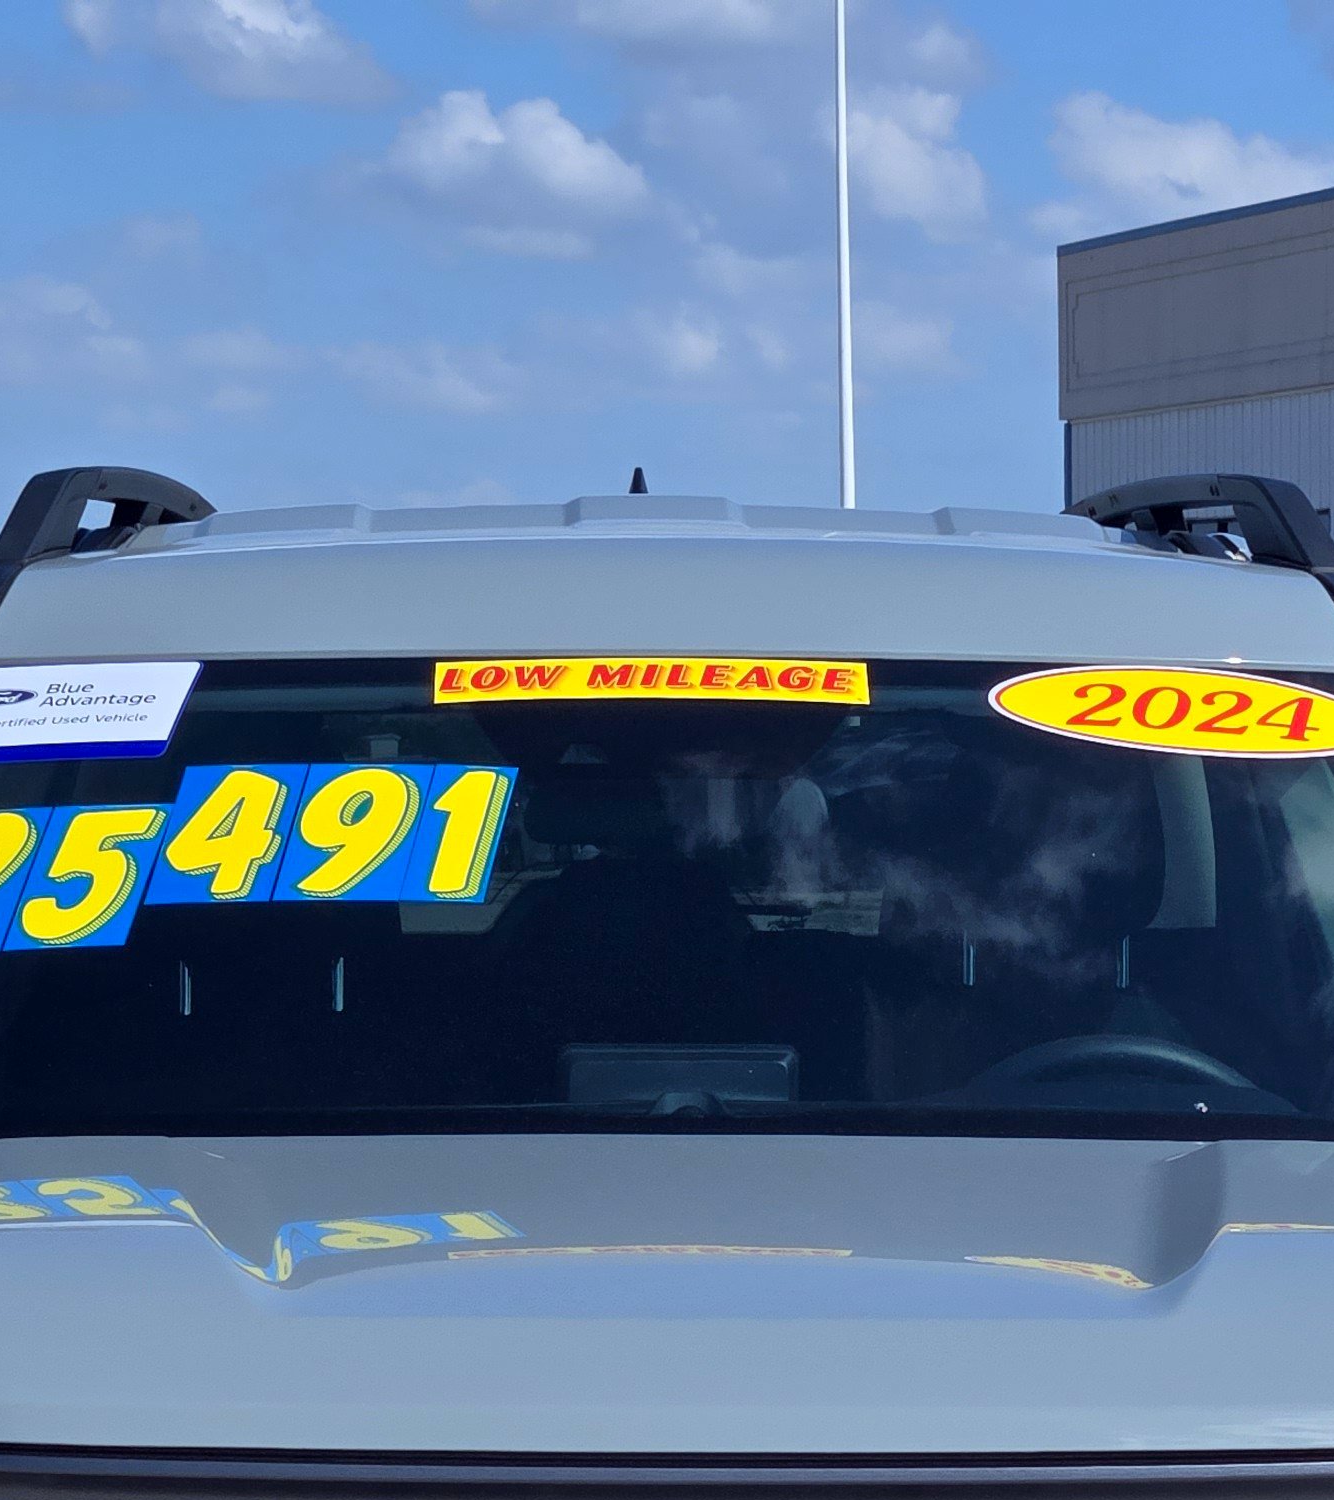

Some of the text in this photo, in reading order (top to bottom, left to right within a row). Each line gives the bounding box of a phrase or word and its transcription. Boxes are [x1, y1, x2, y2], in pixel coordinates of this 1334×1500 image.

[438, 663, 858, 693] LOW MILEAGE
[45, 682, 94, 694] Blue
[39, 693, 156, 708] Advantage
[51, 714, 90, 725] Used
[95, 712, 149, 723] Vehicle
[1066, 682, 1320, 742] 2024
